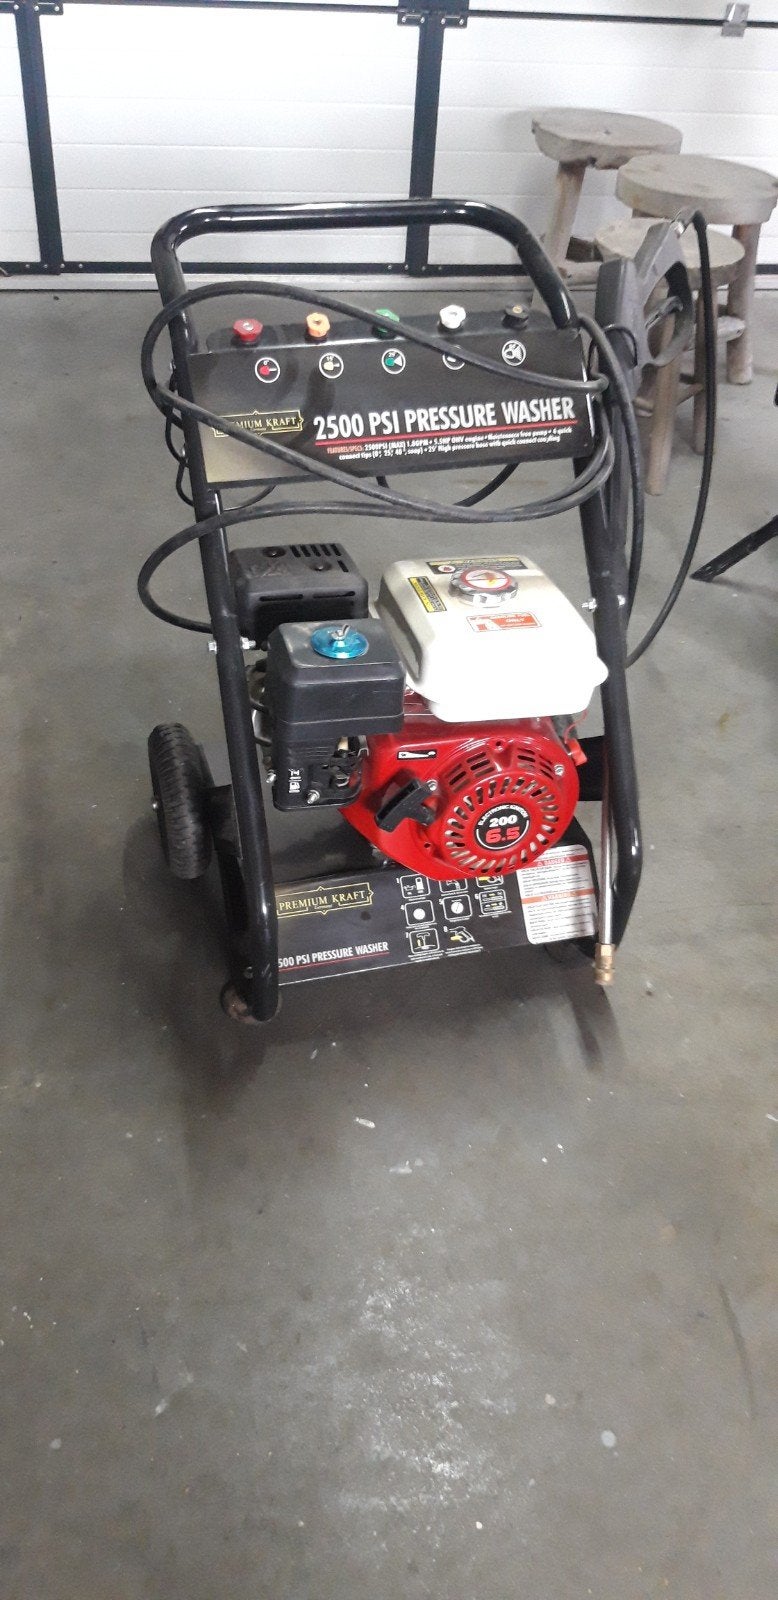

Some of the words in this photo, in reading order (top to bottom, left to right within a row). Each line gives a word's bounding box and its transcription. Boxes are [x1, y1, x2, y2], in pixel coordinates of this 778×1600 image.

[235, 420, 262, 429] MIUM
[265, 416, 297, 427] KRAFT
[313, 413, 364, 440] 2500
[368, 410, 400, 436] PSI
[404, 404, 497, 431] PRESSURE
[501, 396, 576, 424] WASHER
[489, 814, 518, 827] 200
[485, 827, 520, 843] 6.5
[279, 895, 328, 910] PREMIUM
[332, 890, 365, 903] KRAFT
[278, 957, 295, 968] 500
[296, 953, 310, 965] PSI
[312, 946, 354, 962] PRESSURE
[354, 941, 389, 956] WASHER
